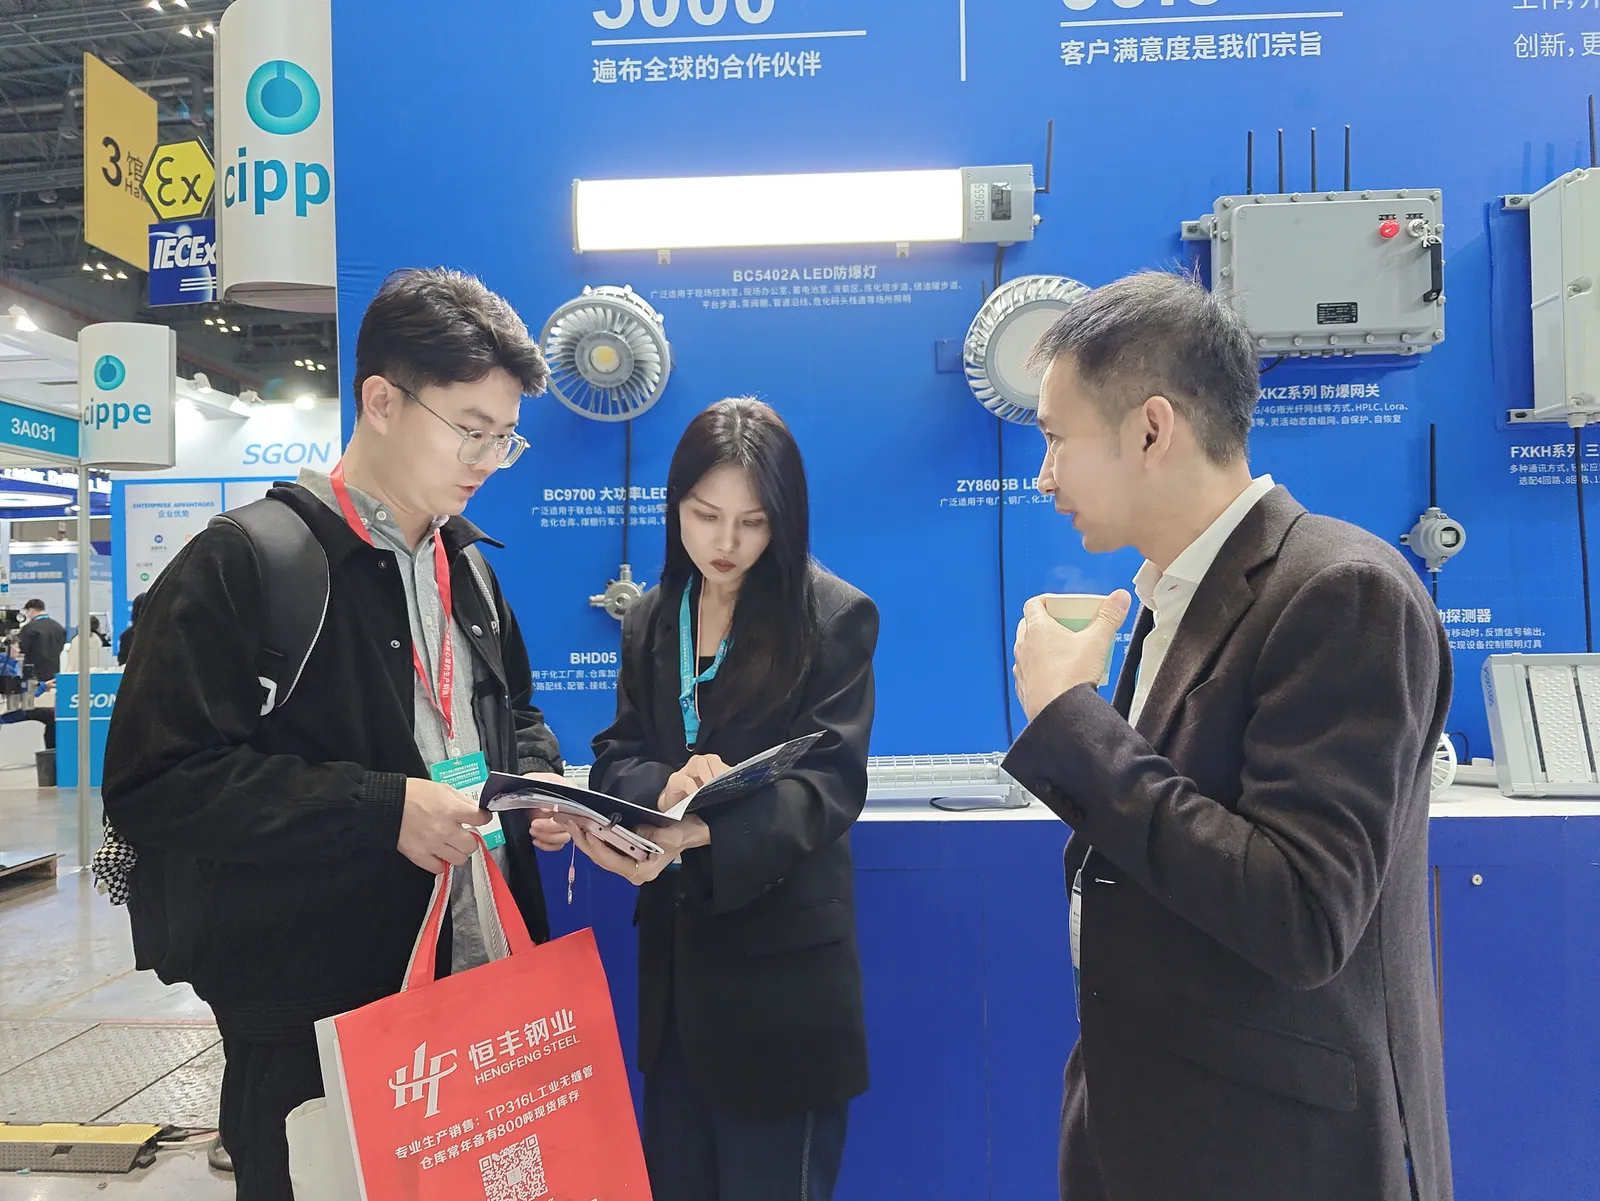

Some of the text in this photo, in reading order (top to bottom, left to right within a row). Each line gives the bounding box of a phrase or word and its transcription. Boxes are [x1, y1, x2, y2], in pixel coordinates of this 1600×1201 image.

[1060, 30, 1322, 66] 客户满意度是我们宗旨
[592, 50, 822, 84] 遍布全球的合作伙伴
[101, 136, 122, 187] 3
[224, 146, 331, 217] cipp
[974, 183, 985, 221] 5012655
[153, 235, 216, 269] IECEx
[733, 269, 800, 282] BC5402A
[1320, 383, 1380, 399] 防爆网关
[11, 418, 56, 442] 3A031
[83, 400, 152, 430] cippe
[242, 442, 331, 465] SGON
[544, 488, 596, 501] BC9700
[956, 478, 1018, 492] ZY8605B
[1518, 475, 1600, 485] 选配4回路、8回路、1
[570, 652, 617, 664] BHD05
[468, 1008, 576, 1070] 恒丰钢业
[474, 1034, 581, 1085] HENGFENG STEEL
[419, 1089, 581, 1170] 仓库常年备有800吨现货库存
